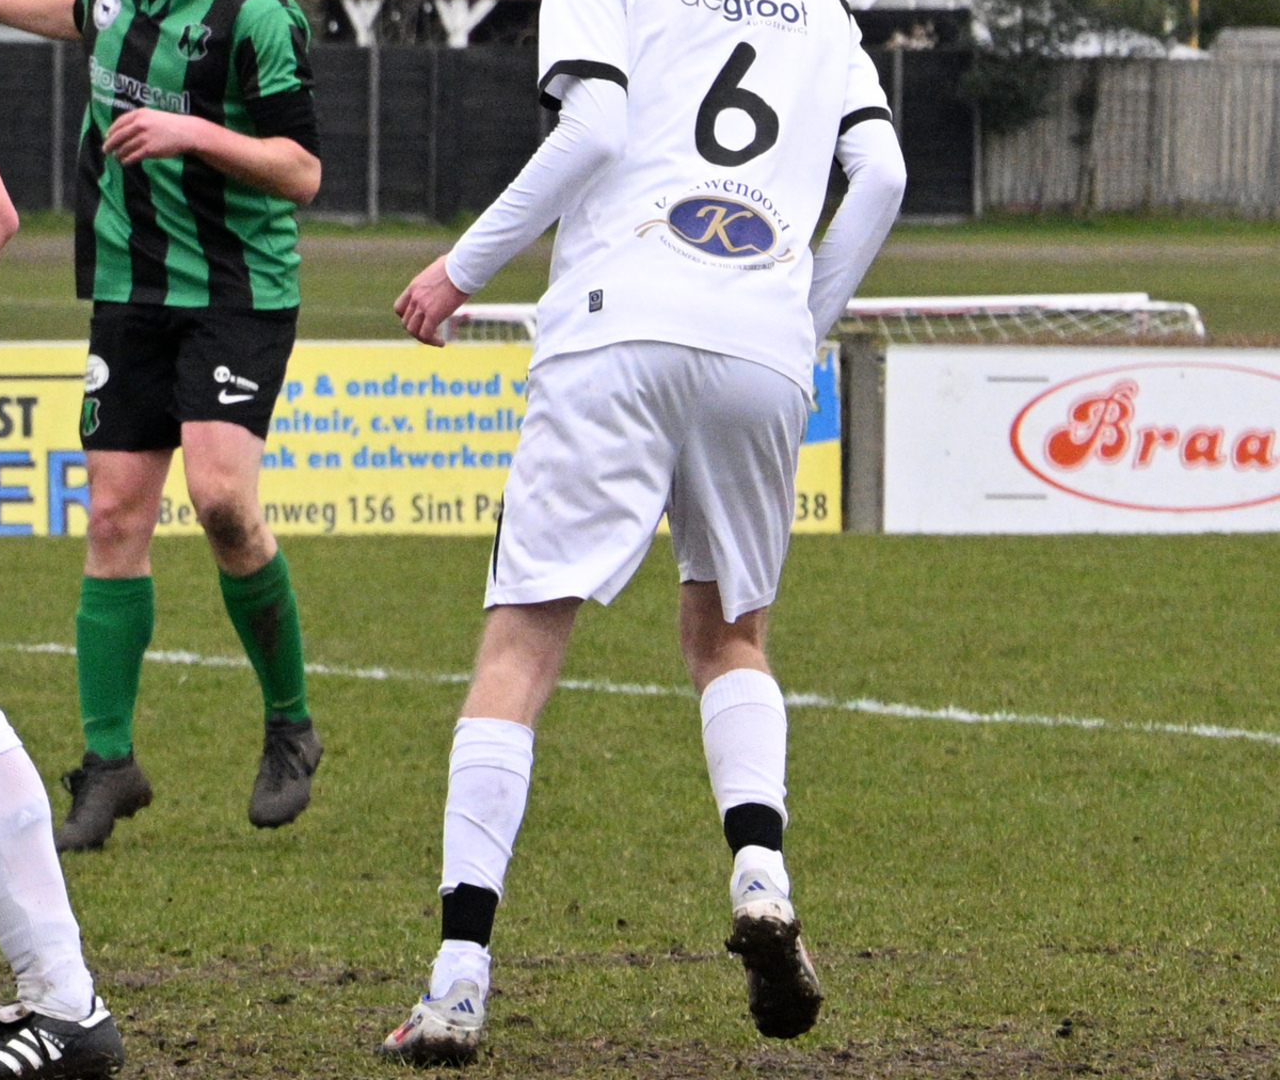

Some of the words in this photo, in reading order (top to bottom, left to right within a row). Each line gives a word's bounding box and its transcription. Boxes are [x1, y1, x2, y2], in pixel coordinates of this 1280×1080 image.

[694, 41, 780, 168] 6
[314, 374, 335, 395] &
[346, 373, 502, 396] onderhoud
[370, 416, 414, 433] c.v.
[1043, 378, 1280, 471] Braa
[307, 452, 341, 469] en
[352, 445, 513, 469] dakwerken
[347, 497, 395, 523] 156
[411, 494, 464, 523] Sint
